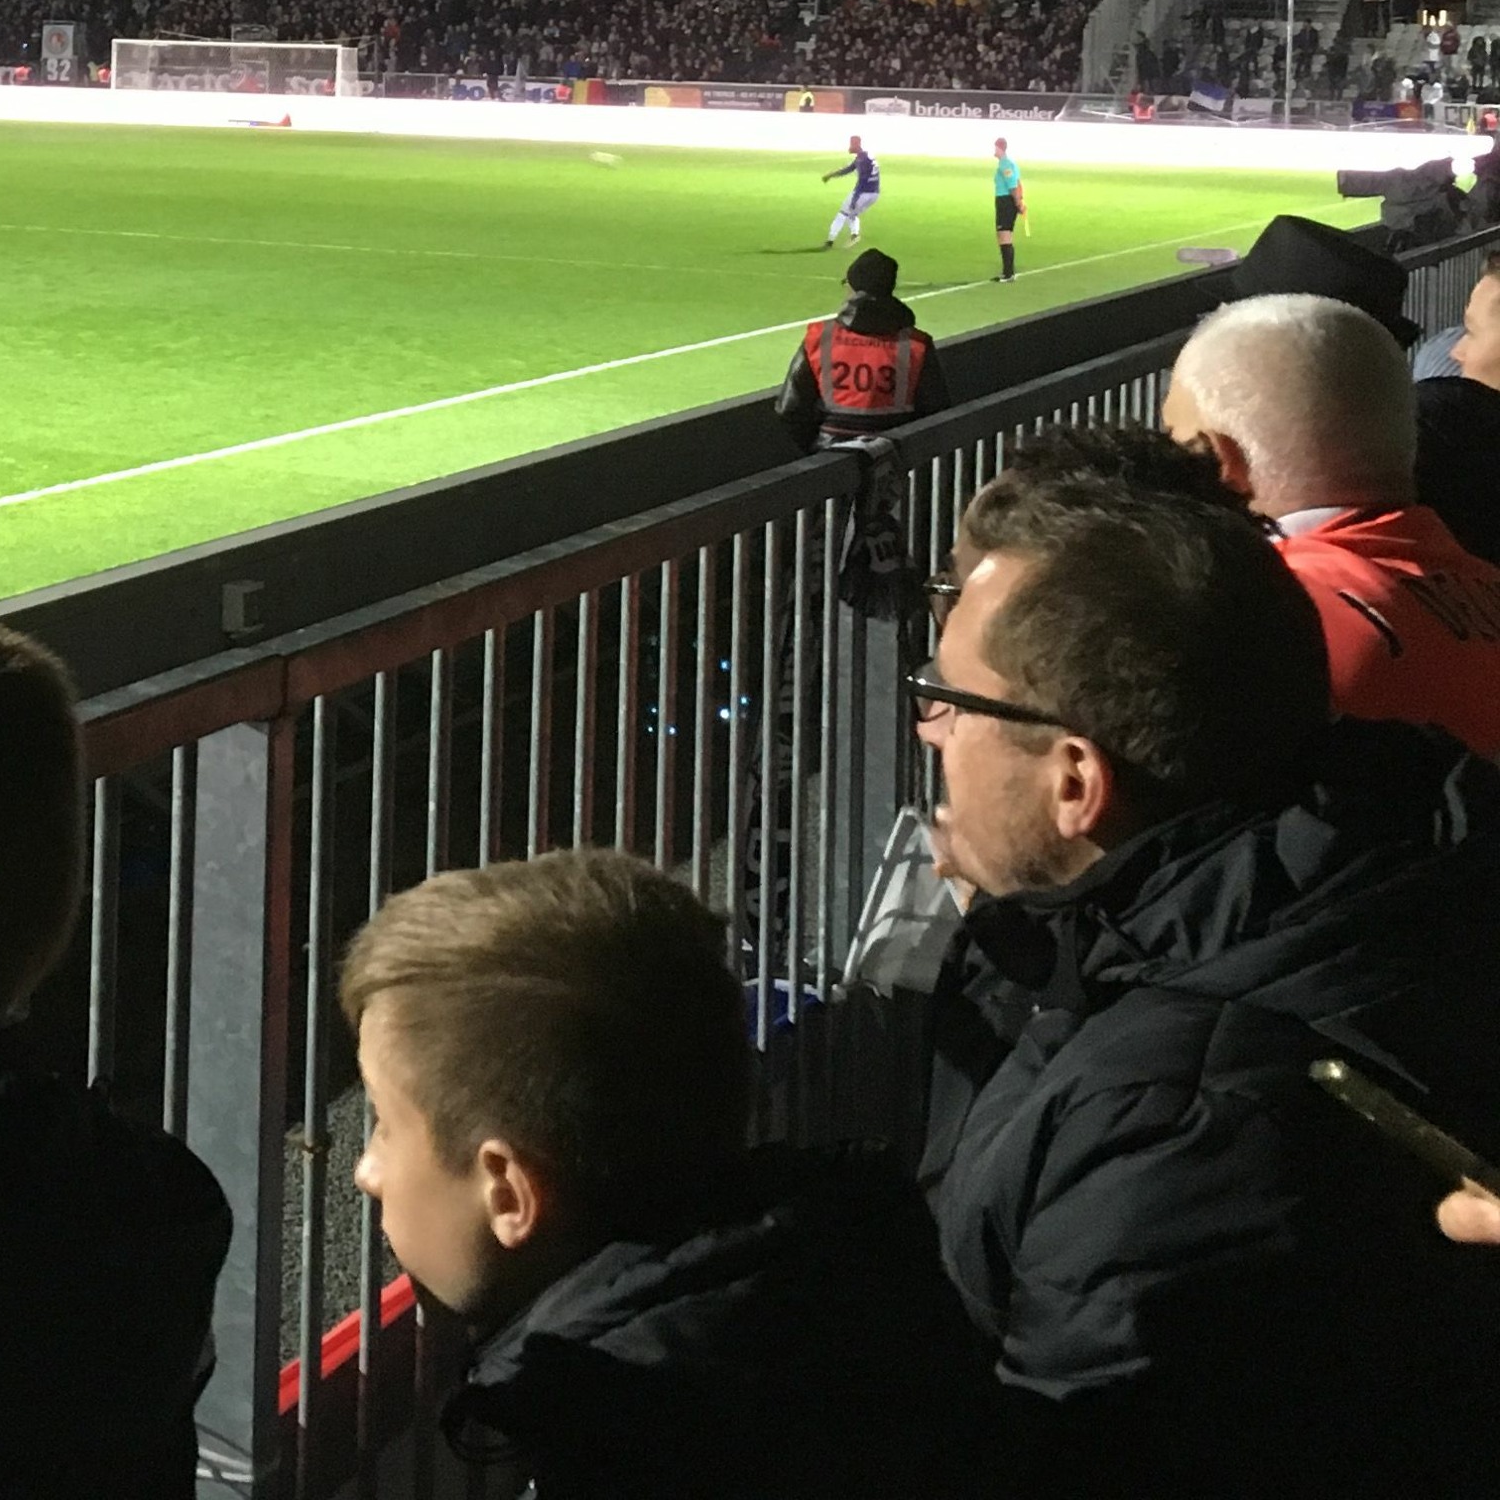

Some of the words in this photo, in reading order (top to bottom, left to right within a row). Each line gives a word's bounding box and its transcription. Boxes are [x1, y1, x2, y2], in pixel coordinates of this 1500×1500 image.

[46, 58, 71, 81] 92
[915, 100, 982, 118] brioche
[989, 102, 1055, 120] Pasquier
[832, 360, 897, 394] 203
